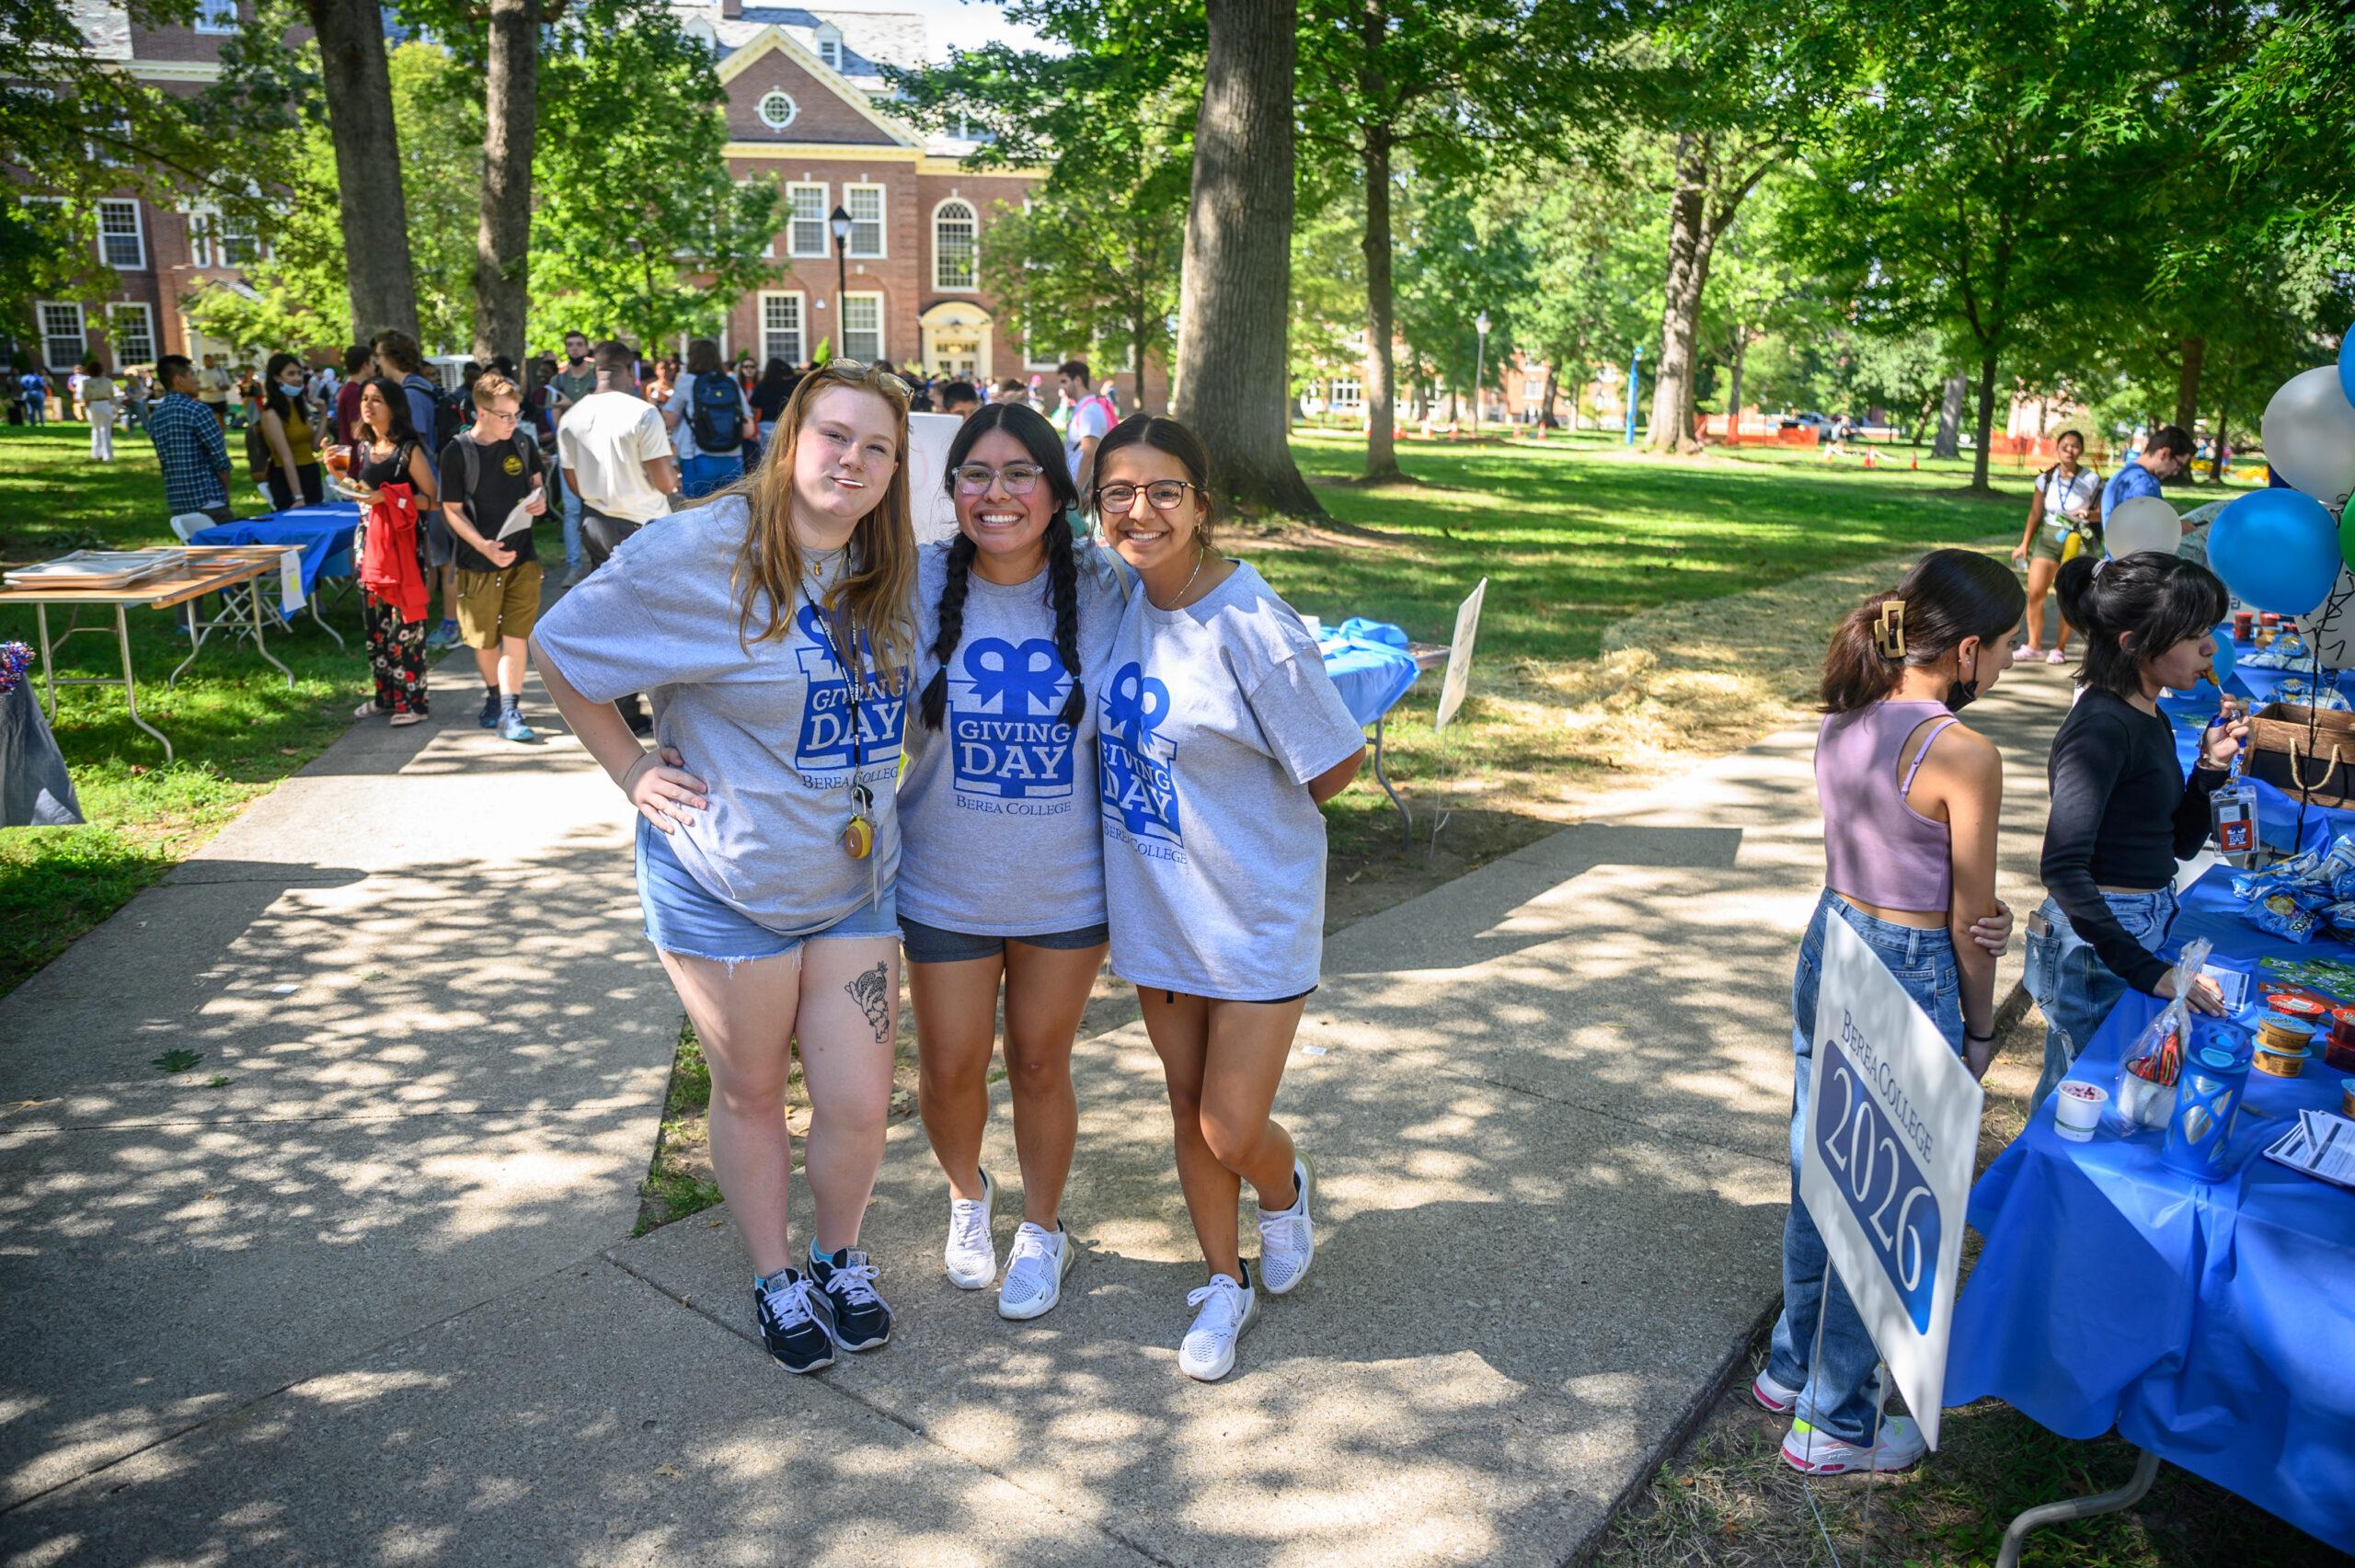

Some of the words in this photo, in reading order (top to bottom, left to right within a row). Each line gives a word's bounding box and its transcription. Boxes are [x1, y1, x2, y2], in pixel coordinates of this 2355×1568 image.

[806, 700, 902, 750] DAY
[958, 720, 1072, 743] GIVING
[802, 774, 849, 790] BEREA
[852, 766, 898, 784] COLLEG
[959, 742, 1067, 779] DAY
[957, 795, 1003, 814] BEREA
[1005, 801, 1072, 816] COLLEGE
[1103, 761, 1172, 824] DAY
[1842, 1009, 1878, 1082] BEREA
[1878, 1062, 1934, 1164] COLLEGE
[1825, 1067, 1932, 1292] 2026
